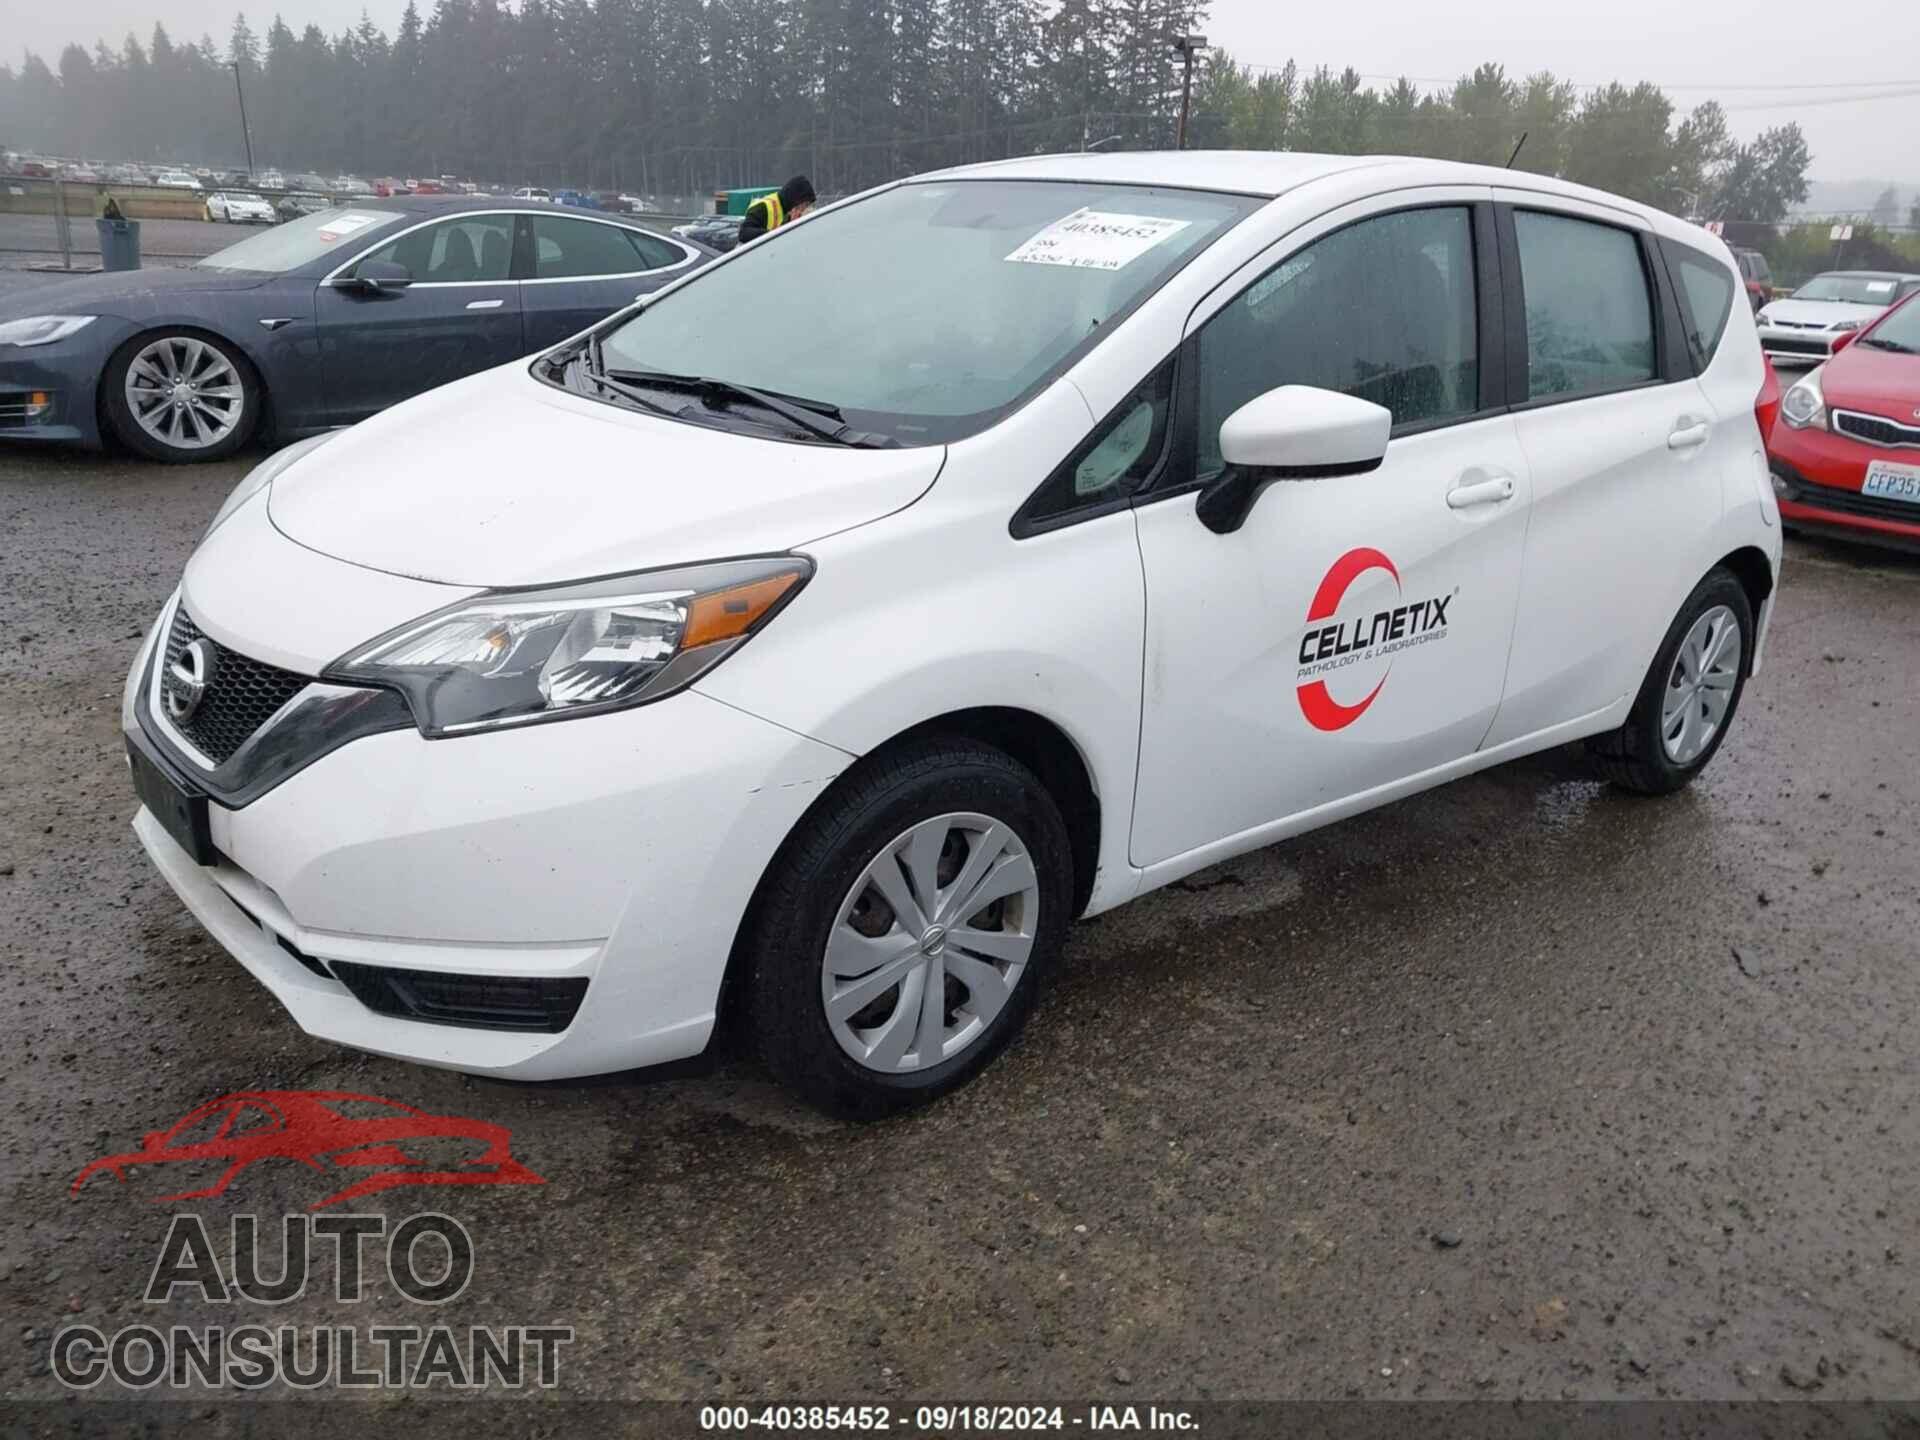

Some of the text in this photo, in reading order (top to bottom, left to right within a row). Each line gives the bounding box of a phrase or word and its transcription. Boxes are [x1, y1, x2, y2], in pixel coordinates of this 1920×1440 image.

[1297, 628, 1448, 680] PATHOLOGY & LABORATORIES
[1299, 595, 1452, 664] CELLNETIX
